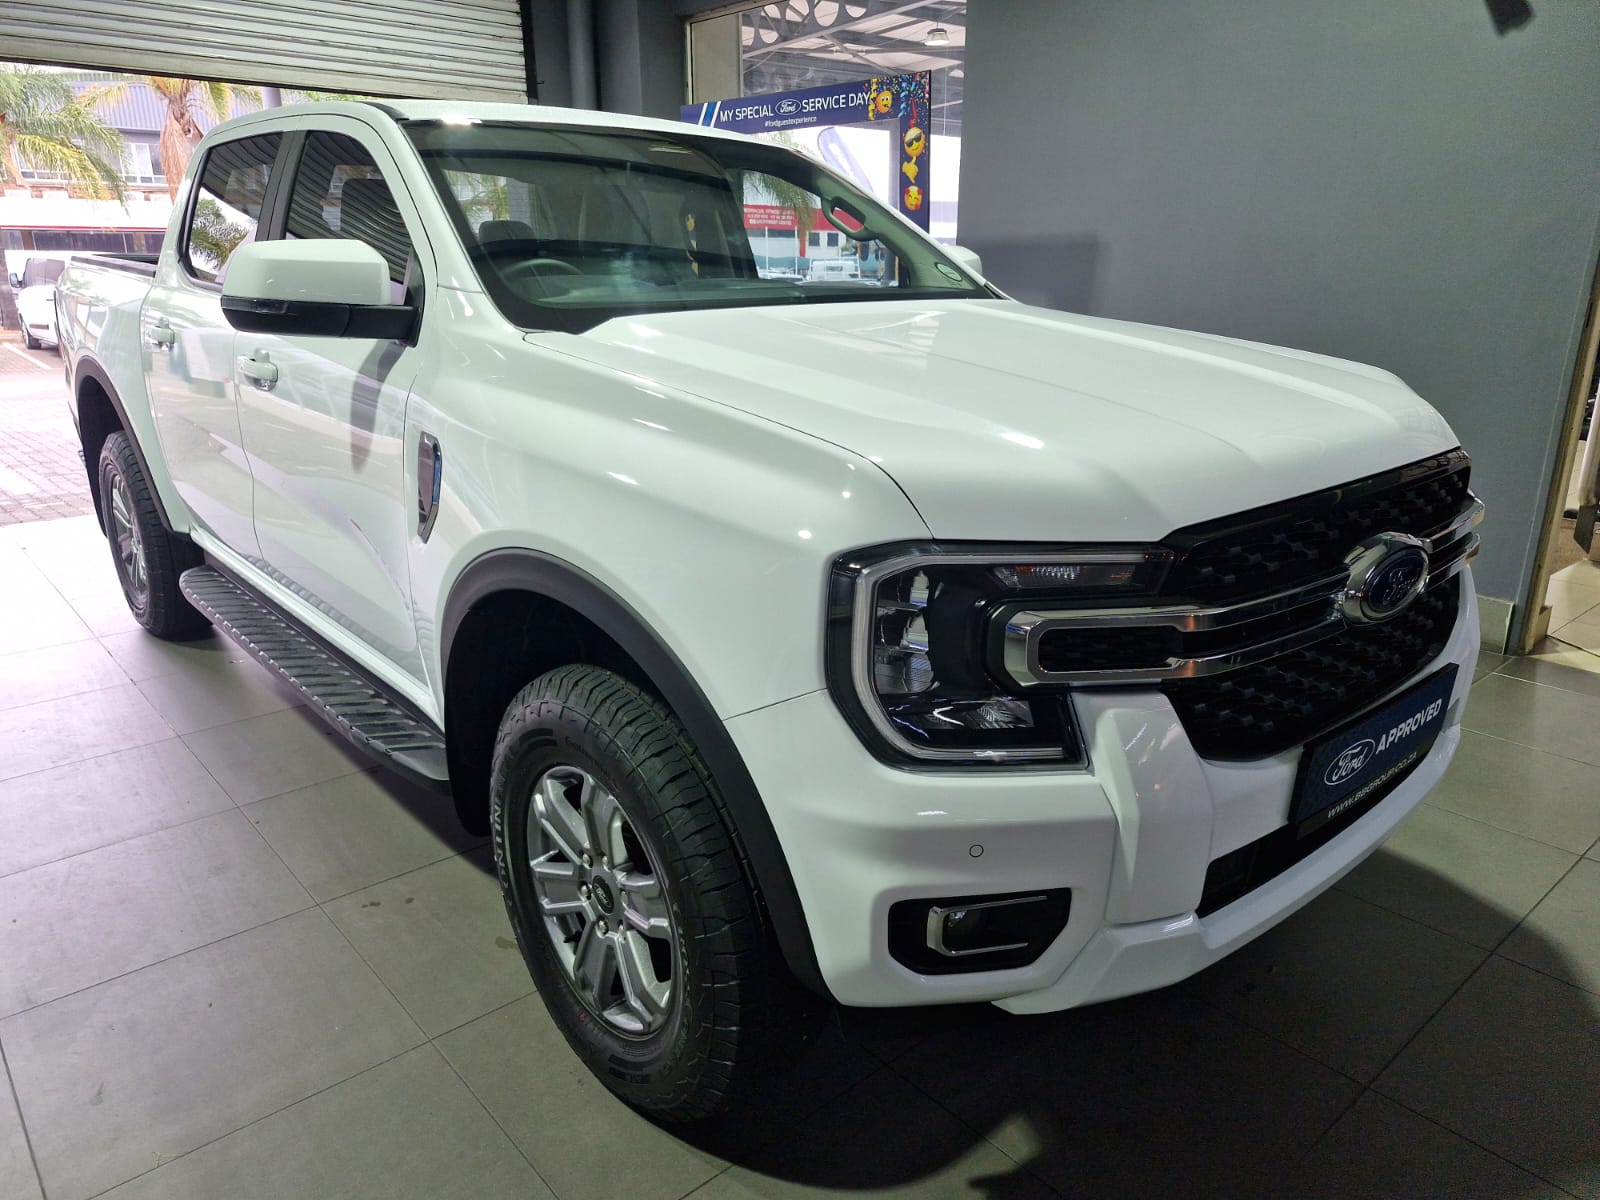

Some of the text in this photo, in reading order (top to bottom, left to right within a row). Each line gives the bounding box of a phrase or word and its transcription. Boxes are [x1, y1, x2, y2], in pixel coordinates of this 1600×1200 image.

[720, 92, 871, 123] MY SPECIAL Ford SERVICE DAY
[1330, 698, 1442, 782] Ford APPROVED
